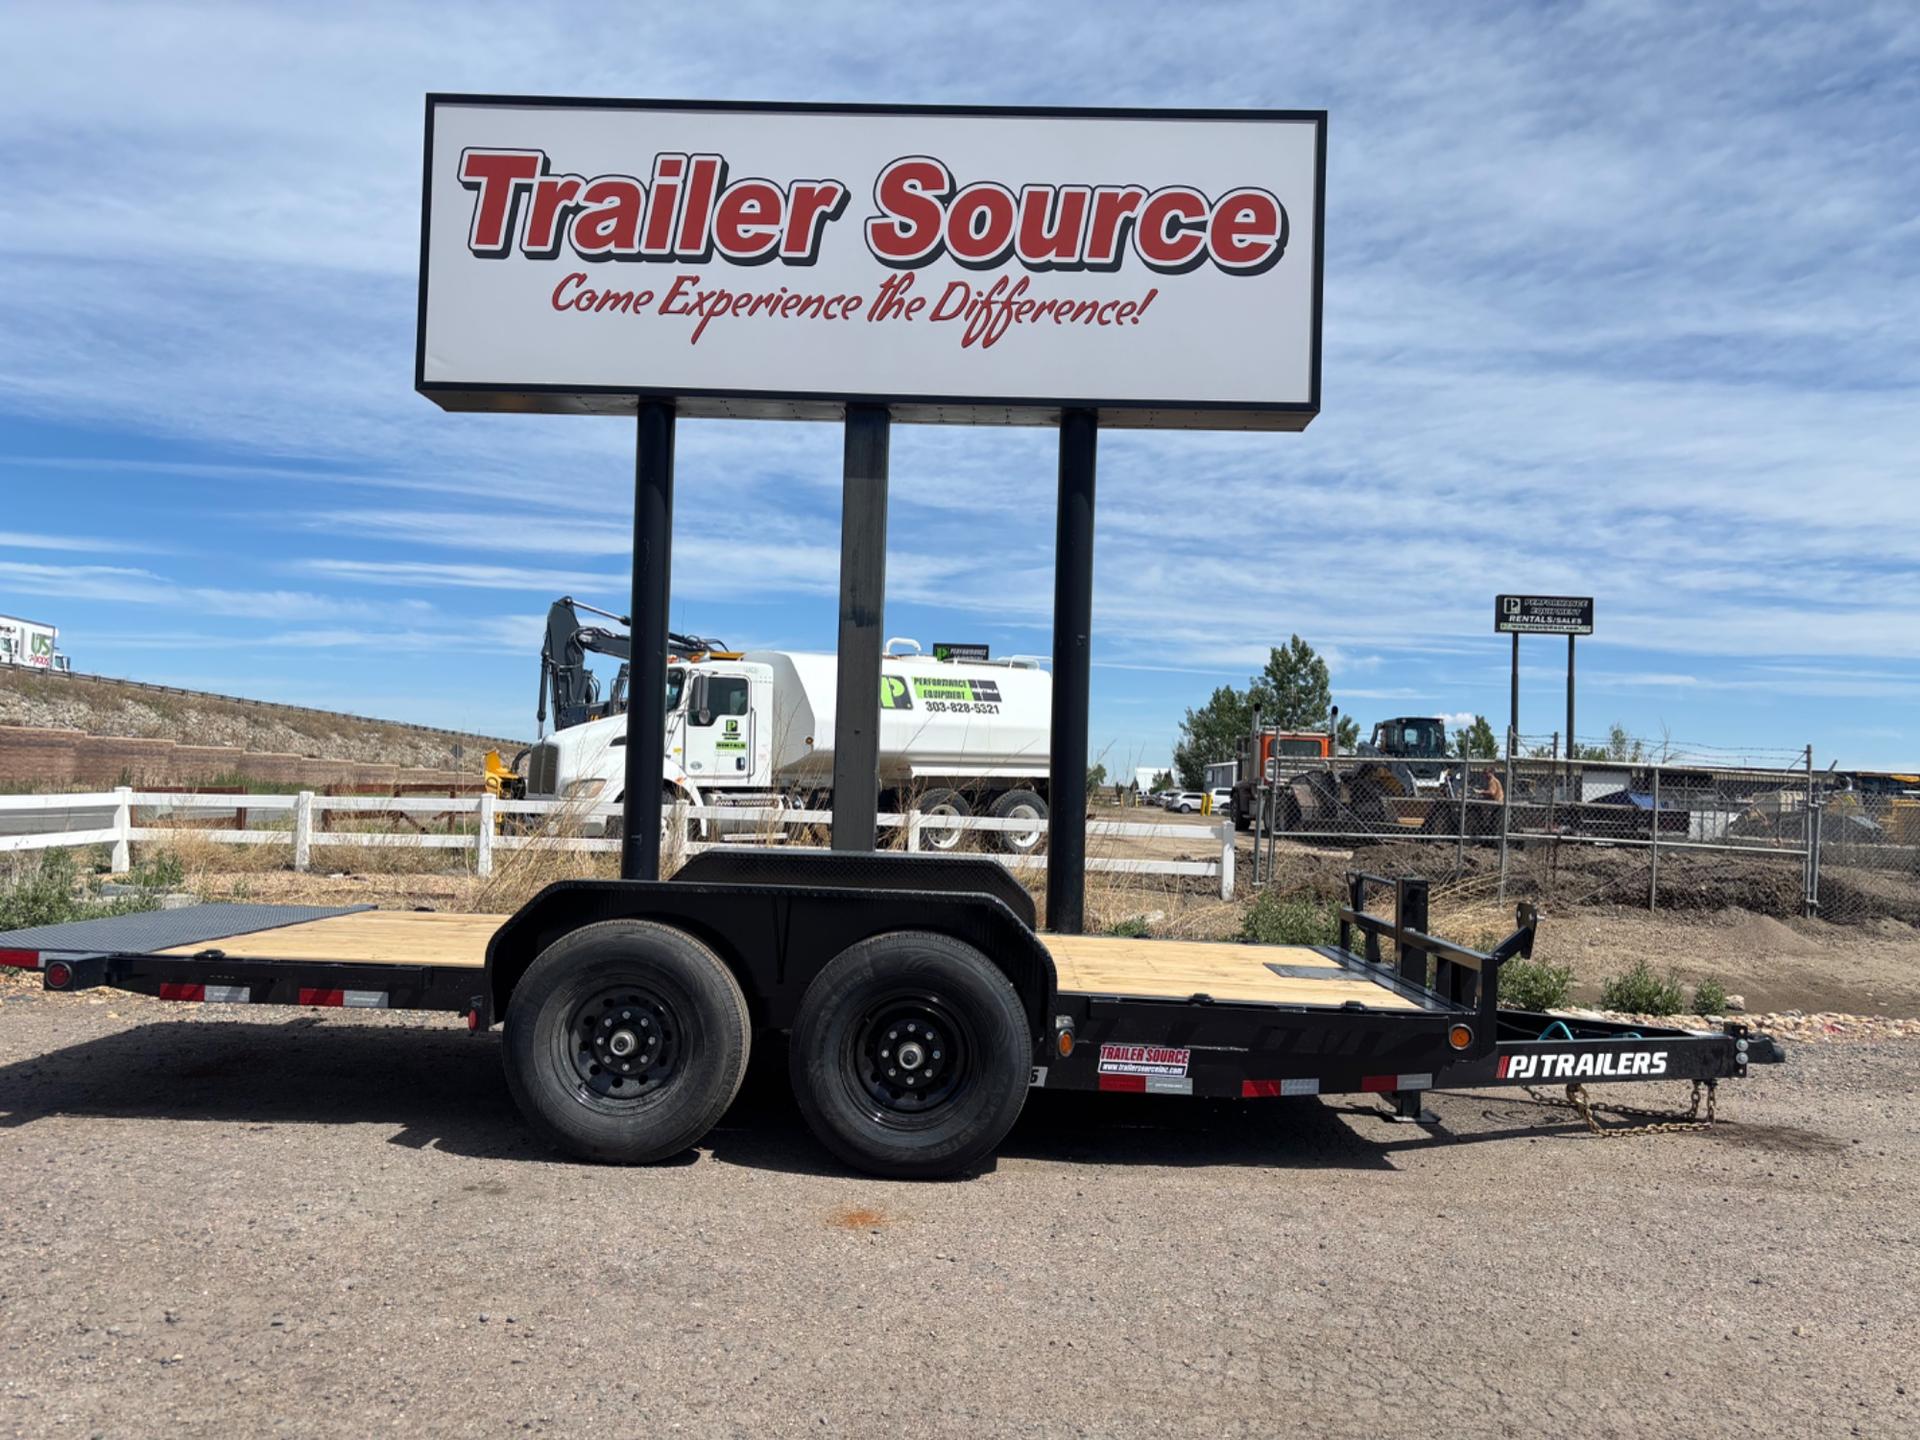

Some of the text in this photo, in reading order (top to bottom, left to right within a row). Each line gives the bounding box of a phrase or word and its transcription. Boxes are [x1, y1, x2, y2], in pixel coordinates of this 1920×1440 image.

[457, 146, 1290, 277] Trailer Source
[552, 271, 1159, 350] Come Experience the Difference!
[913, 676, 967, 688] PERFORMANCE
[923, 689, 966, 700] EQUIPMENT
[925, 701, 1000, 715] 303-828-5321
[1101, 1046, 1189, 1064] TRAILER SOURCE
[1506, 1052, 1668, 1079] PJ TRAILERS
